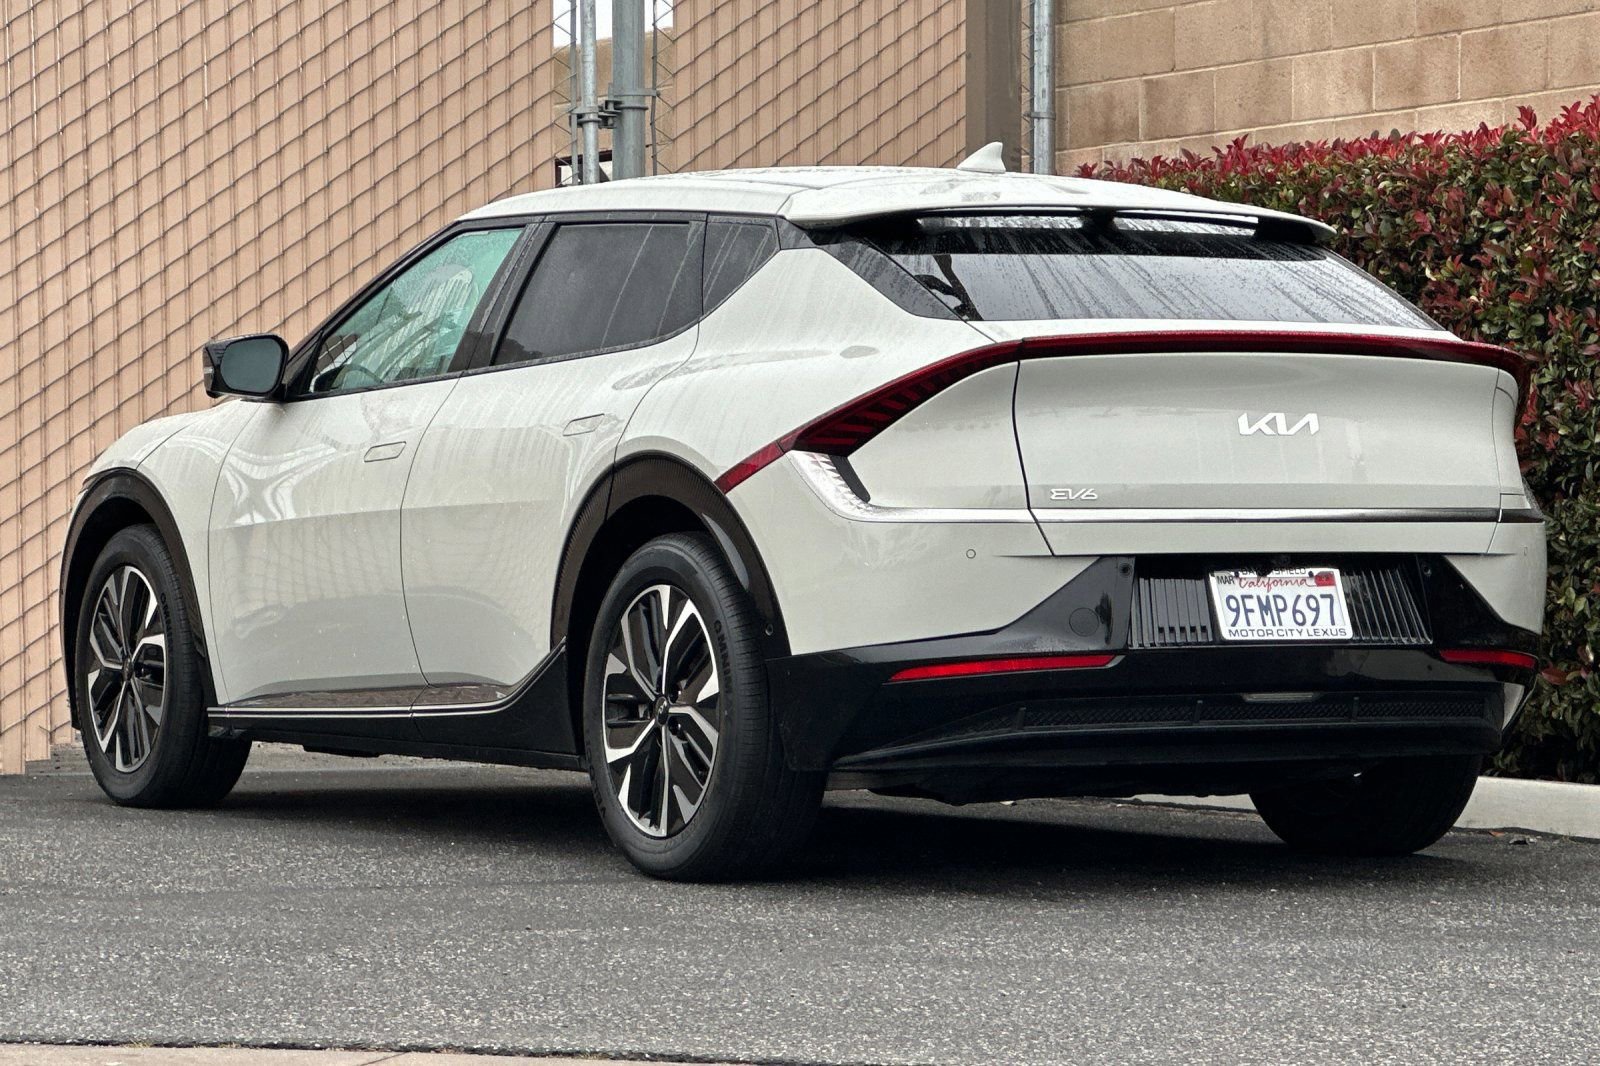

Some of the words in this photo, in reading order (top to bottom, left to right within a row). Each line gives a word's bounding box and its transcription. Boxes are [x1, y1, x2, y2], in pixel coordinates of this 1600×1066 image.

[1237, 412, 1320, 436] KIA
[1050, 488, 1098, 501] EV6
[1216, 575, 1235, 585] MAR
[1238, 576, 1313, 593] California
[1225, 593, 1336, 627] 9FMP697
[1228, 628, 1274, 638] MOTOR
[1277, 628, 1304, 638] CITY
[1307, 627, 1347, 638] LEXUS
